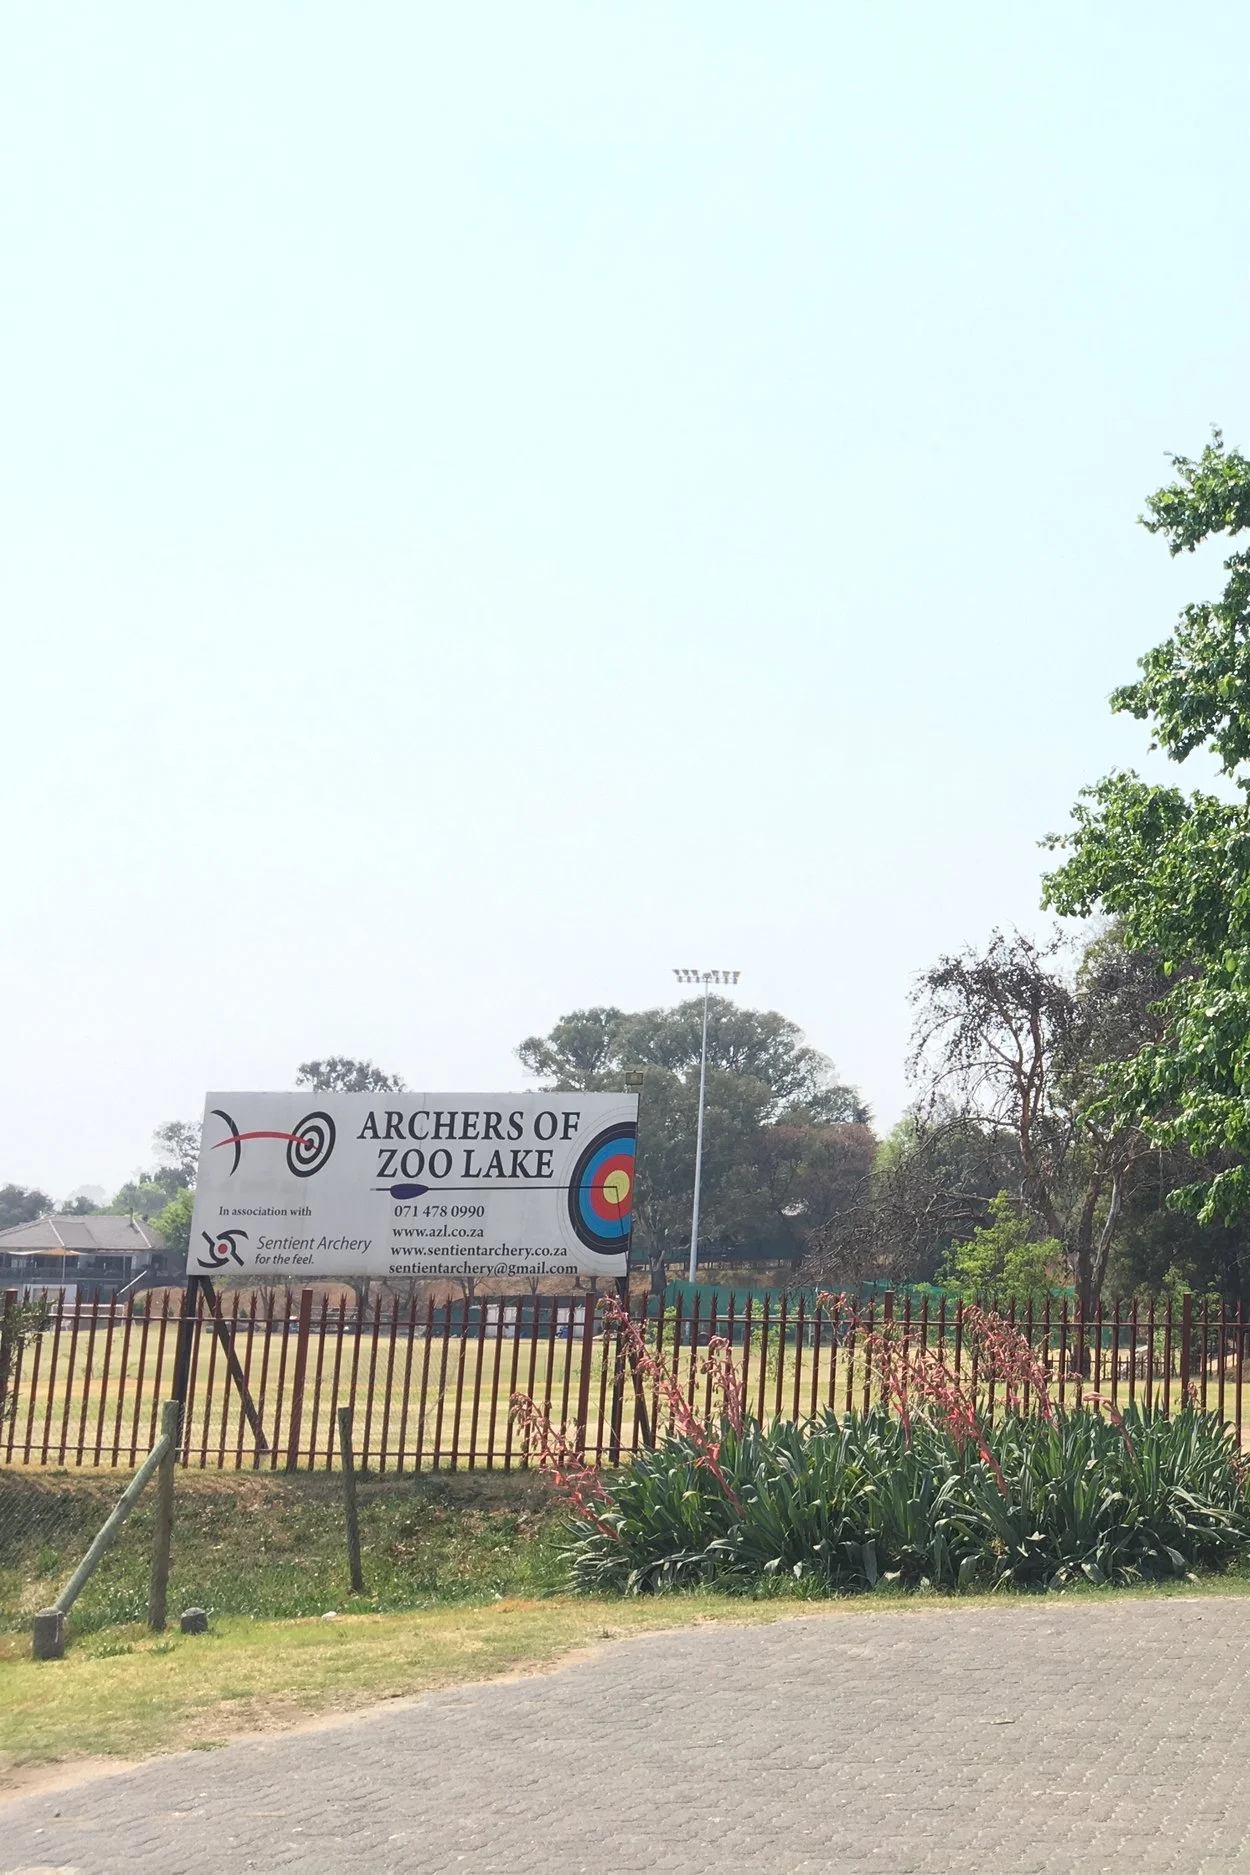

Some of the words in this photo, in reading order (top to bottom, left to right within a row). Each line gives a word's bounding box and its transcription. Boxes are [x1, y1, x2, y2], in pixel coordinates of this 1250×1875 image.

[357, 1110, 524, 1141] ARCHERS
[533, 1110, 581, 1141] OF
[376, 1149, 453, 1179] ZOO
[460, 1149, 555, 1179] LAKE
[219, 1206, 230, 1216] In
[231, 1206, 287, 1217] association
[289, 1206, 312, 1217] with
[394, 1205, 418, 1218] 071
[422, 1205, 448, 1218] 478
[451, 1205, 485, 1218] 0990
[392, 1224, 484, 1238] www.azl.co.za
[256, 1235, 315, 1250] Sentient
[316, 1235, 372, 1254] Archery
[390, 1243, 568, 1260] www.sentientarchery.co.za
[254, 1253, 271, 1265] for
[272, 1253, 290, 1265] the
[292, 1253, 315, 1265] feel.
[388, 1261, 579, 1277] sentientarchery@gmail.com
